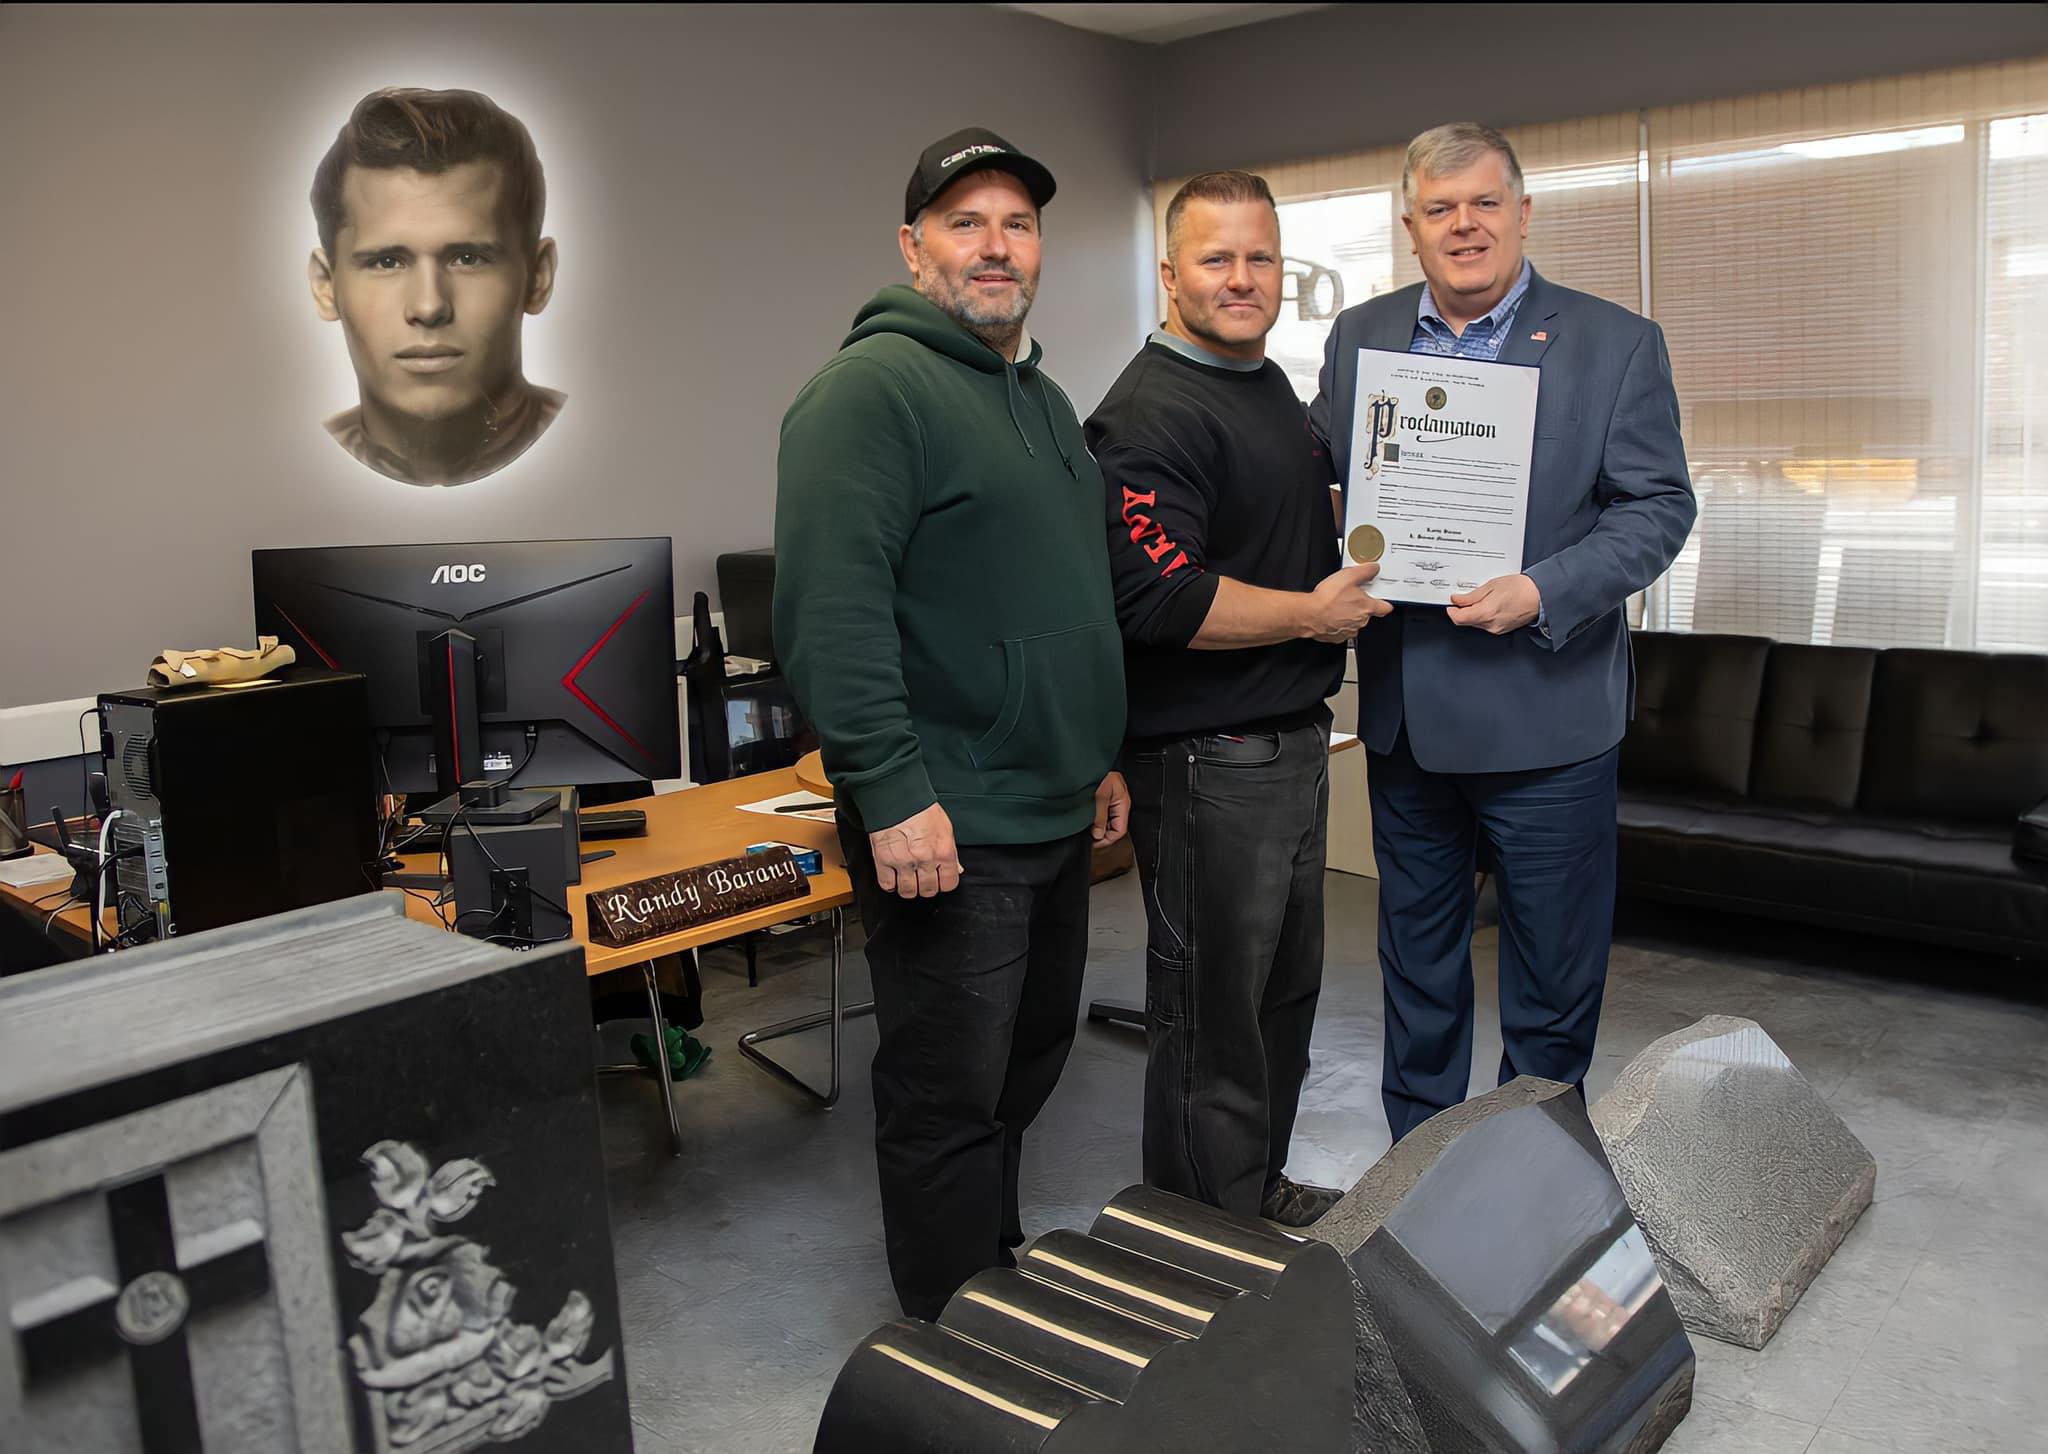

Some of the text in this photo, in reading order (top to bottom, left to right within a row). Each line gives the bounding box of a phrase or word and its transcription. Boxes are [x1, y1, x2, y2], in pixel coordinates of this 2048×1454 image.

[1364, 390, 1496, 469] Proclamation
[431, 564, 486, 584] AOC
[607, 859, 798, 924] Randy Barany
